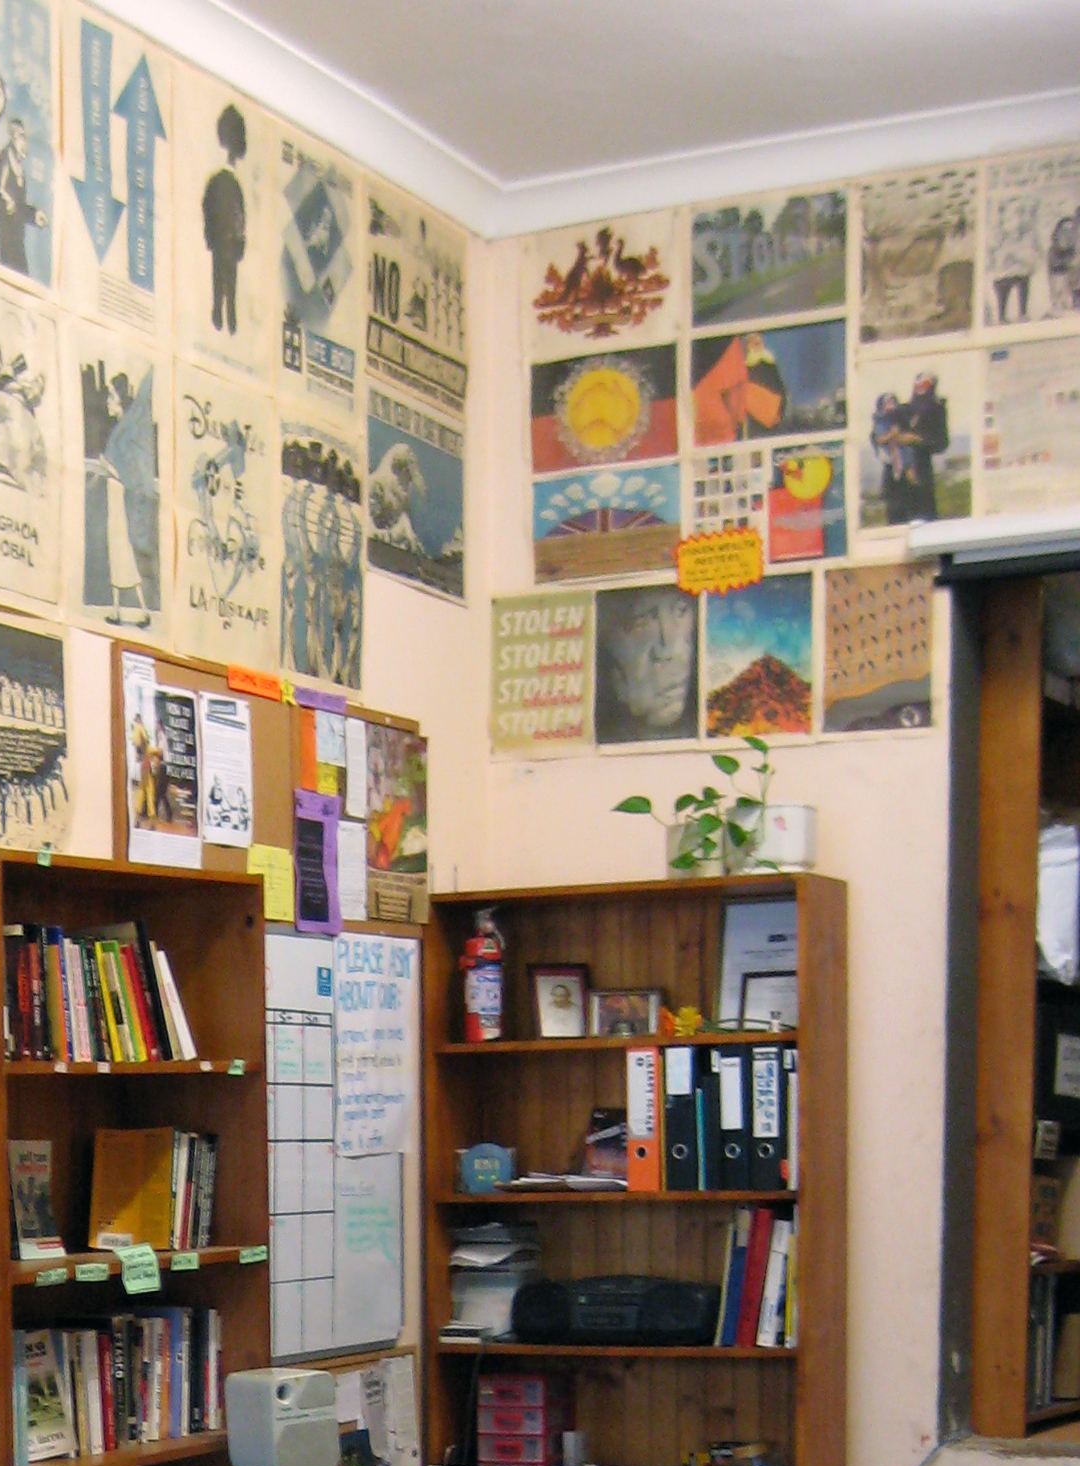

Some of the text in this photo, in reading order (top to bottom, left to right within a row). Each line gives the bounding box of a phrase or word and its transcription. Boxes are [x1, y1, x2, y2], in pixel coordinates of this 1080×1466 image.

[499, 606, 585, 638] STOLEN
[499, 640, 584, 671] STOLEN
[498, 673, 584, 704] STOLEN
[498, 704, 584, 736] STOLEN
